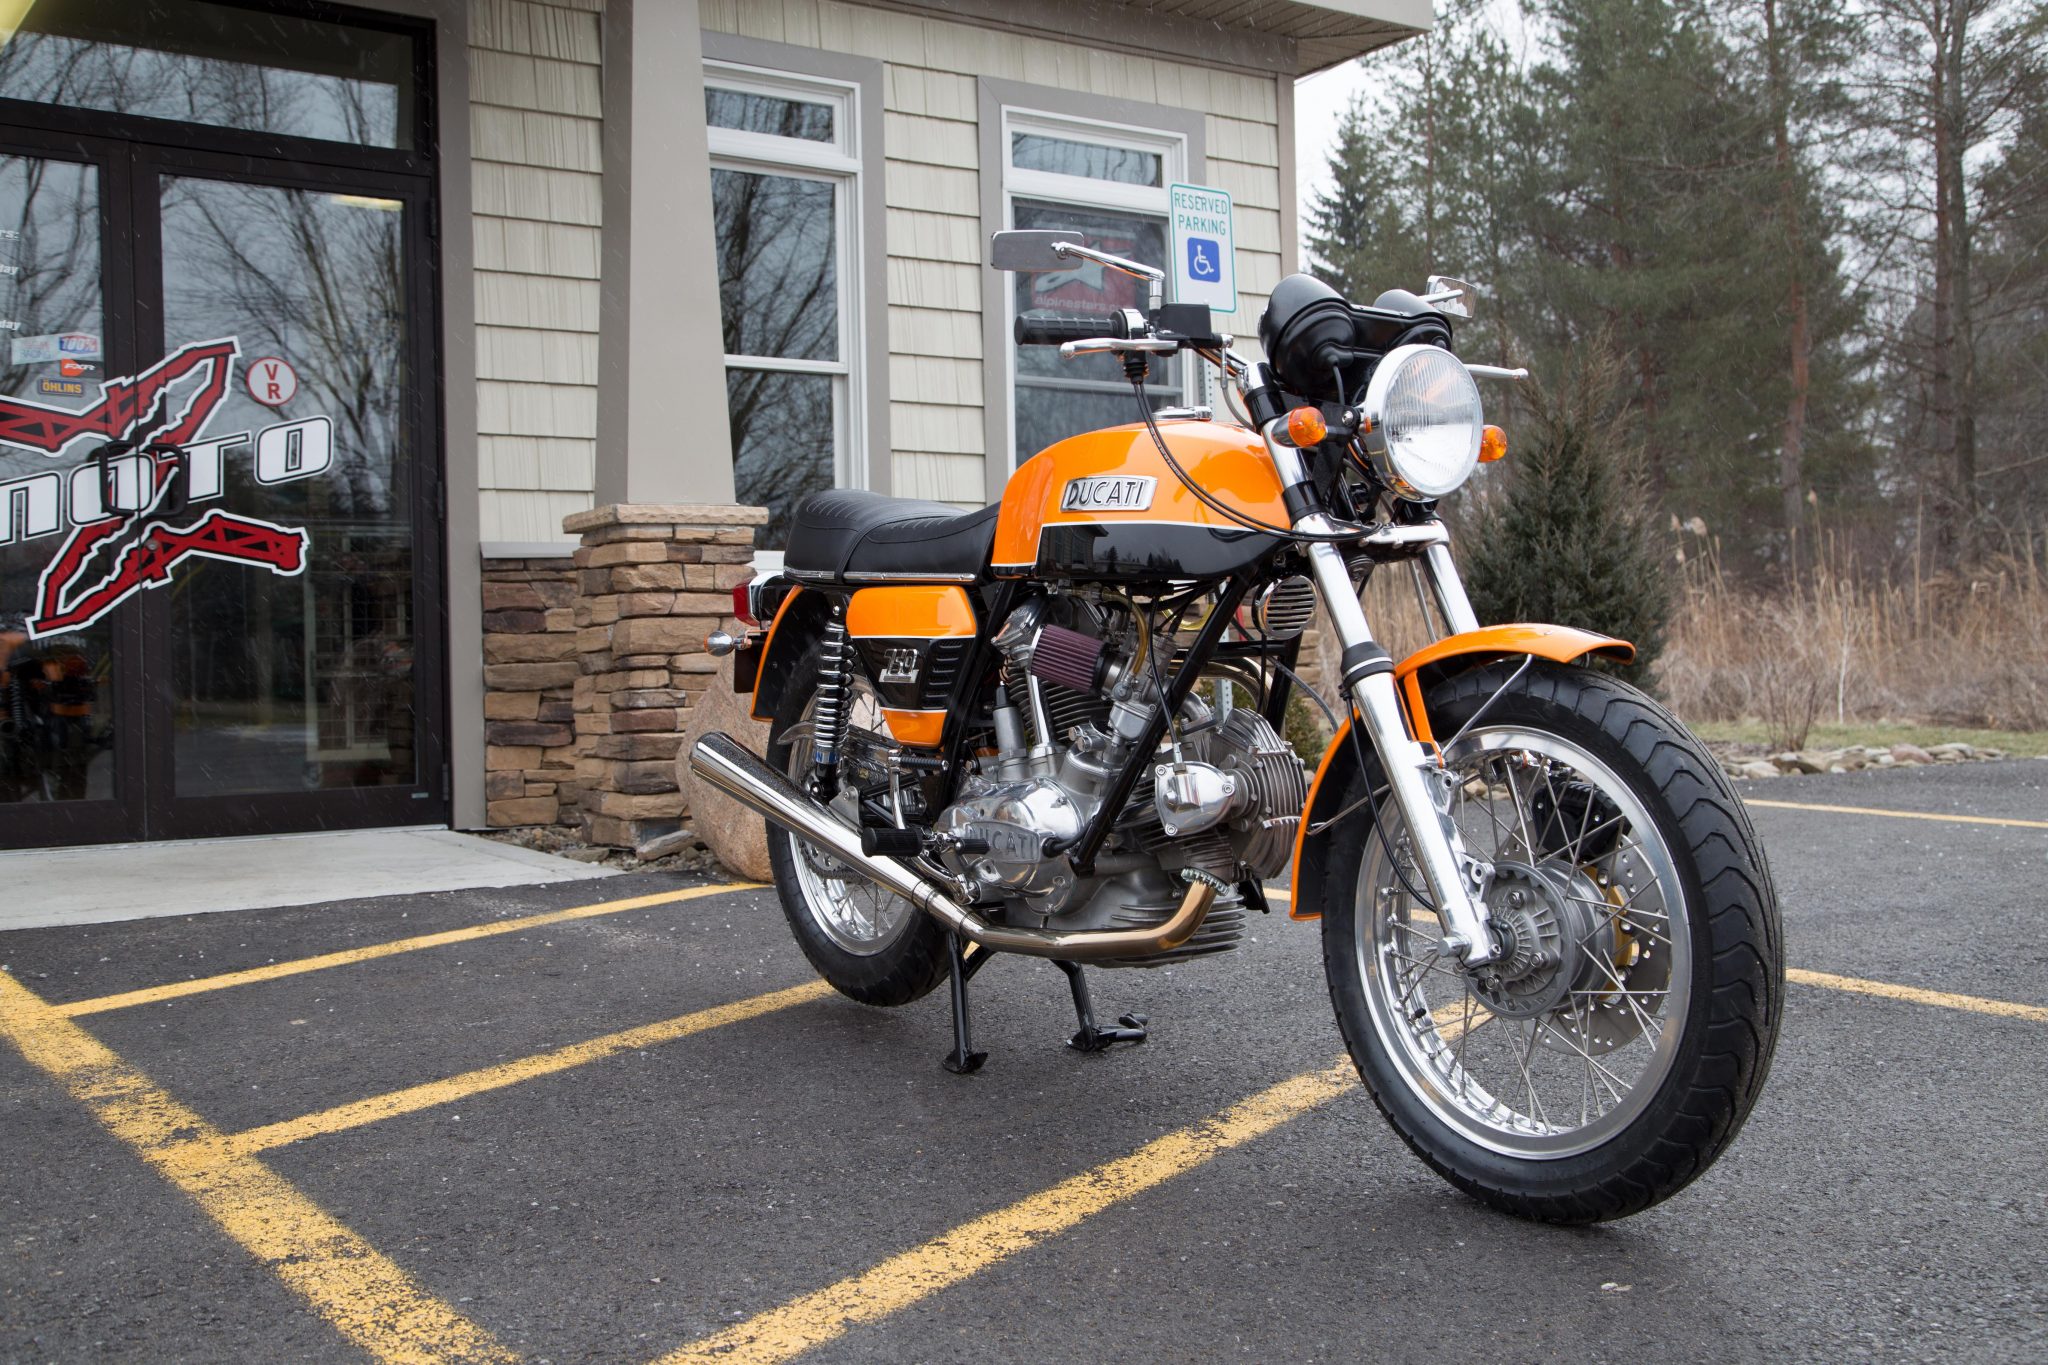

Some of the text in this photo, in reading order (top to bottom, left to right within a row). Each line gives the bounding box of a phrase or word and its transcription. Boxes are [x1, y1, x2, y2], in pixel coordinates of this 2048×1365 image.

[1174, 192, 1228, 215] RESERVED
[1178, 215, 1227, 236] PARKING
[62, 337, 97, 352] 100%
[63, 363, 96, 371] FXR
[264, 363, 279, 381] V
[42, 378, 82, 393] ÖHLINS
[267, 382, 282, 400] R
[1066, 481, 1144, 507] DUCATI
[884, 648, 918, 676] 750
